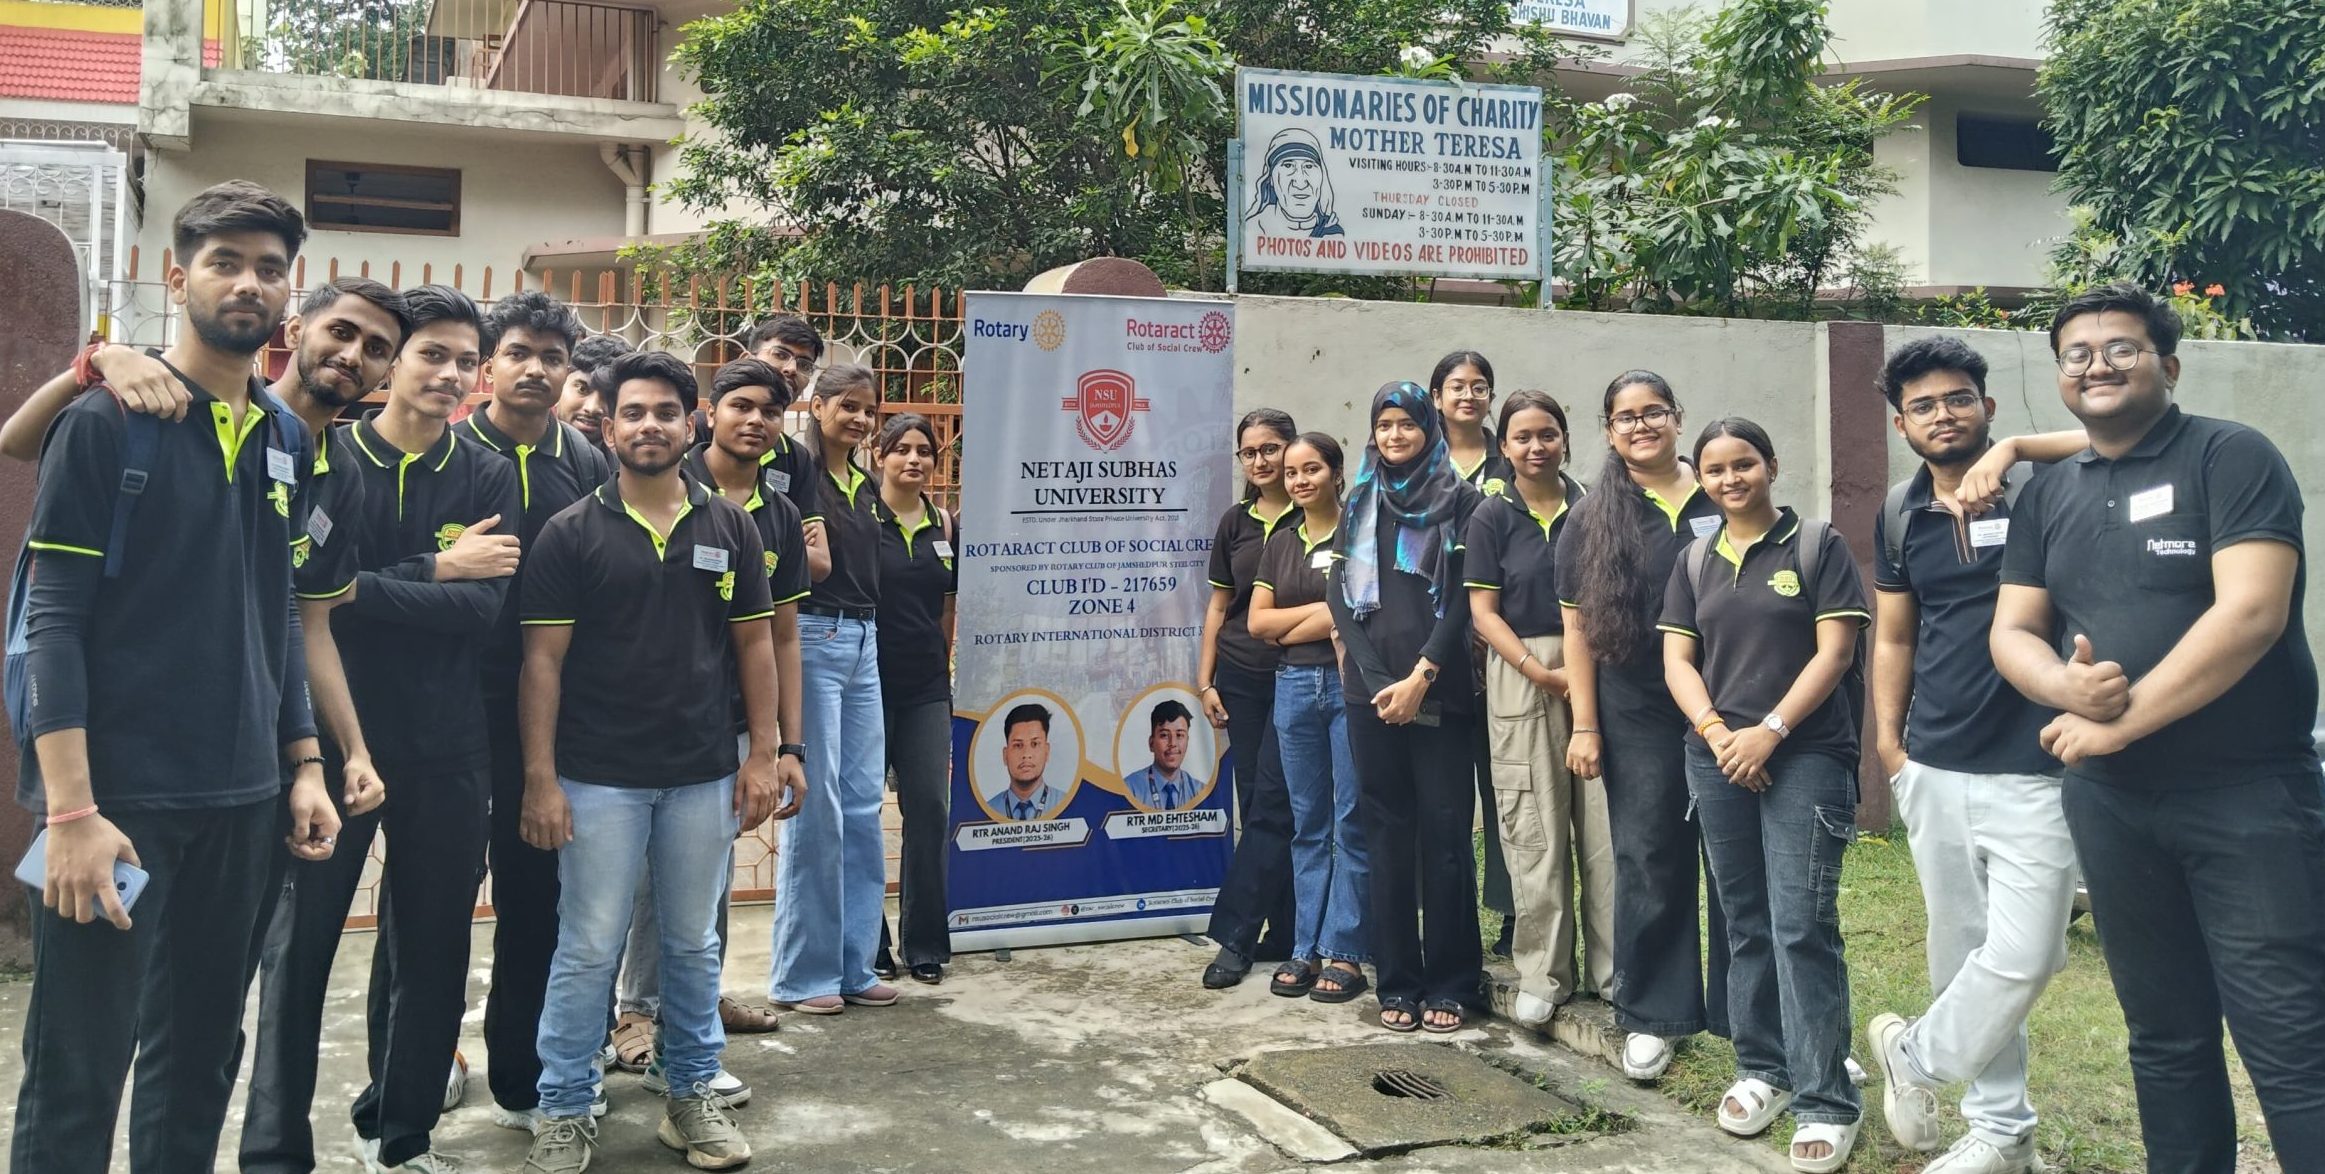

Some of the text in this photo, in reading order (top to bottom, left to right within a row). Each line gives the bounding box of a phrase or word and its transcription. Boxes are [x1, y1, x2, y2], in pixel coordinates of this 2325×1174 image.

[1510, 4, 1555, 23] SHISHU
[1561, 9, 1611, 29] BHAVAN
[1248, 82, 1539, 130] MISSIONARIES OF CHARITY
[1329, 126, 1523, 160] MOTHER TERESA
[1349, 157, 1393, 171] VISITING
[1476, 164, 1488, 176] TO
[1476, 180, 1487, 191] TO
[1373, 191, 1479, 208] THURSDAY CLOSED
[1467, 212, 1479, 225] TO
[1465, 228, 1478, 240] TO
[1257, 235, 1528, 266] PHOTOS AND VIDEOS ARE PROHIBITED
[974, 318, 1029, 341] Rotary
[1126, 318, 1195, 339] Rotaract
[1127, 342, 1202, 352] Club of Social Crew
[1094, 388, 1118, 401] NSU
[1020, 460, 1178, 484] NETAJI SUBHAS
[1034, 487, 1166, 506] UNIVERSITY
[1126, 515, 1153, 524] University
[965, 542, 1056, 558] ROTARACT
[1060, 540, 1102, 554] CLUB
[1105, 540, 1126, 553] OF
[1128, 540, 1184, 552] SOCIAL
[1186, 538, 1216, 552] CRE
[990, 564, 1037, 572] SPONSORED
[1085, 562, 1105, 570] CLUB
[1117, 560, 1168, 570] JAMSHEDPUR
[1170, 560, 1188, 568] STEEL
[1190, 560, 1206, 568] CITY
[1026, 579, 1078, 595] CLUB
[1081, 578, 1106, 594] I'D
[1124, 576, 1177, 592] 217659
[1068, 598, 1136, 616] ZONE 4
[974, 632, 1030, 646] ROTARY
[1032, 629, 1138, 642] INTERNATIONAL
[1140, 626, 1196, 638] DISTRICT
[1126, 811, 1218, 826] RTR MD EHTESHAM
[972, 822, 1070, 838] RTR ANAND RAJ SINGH
